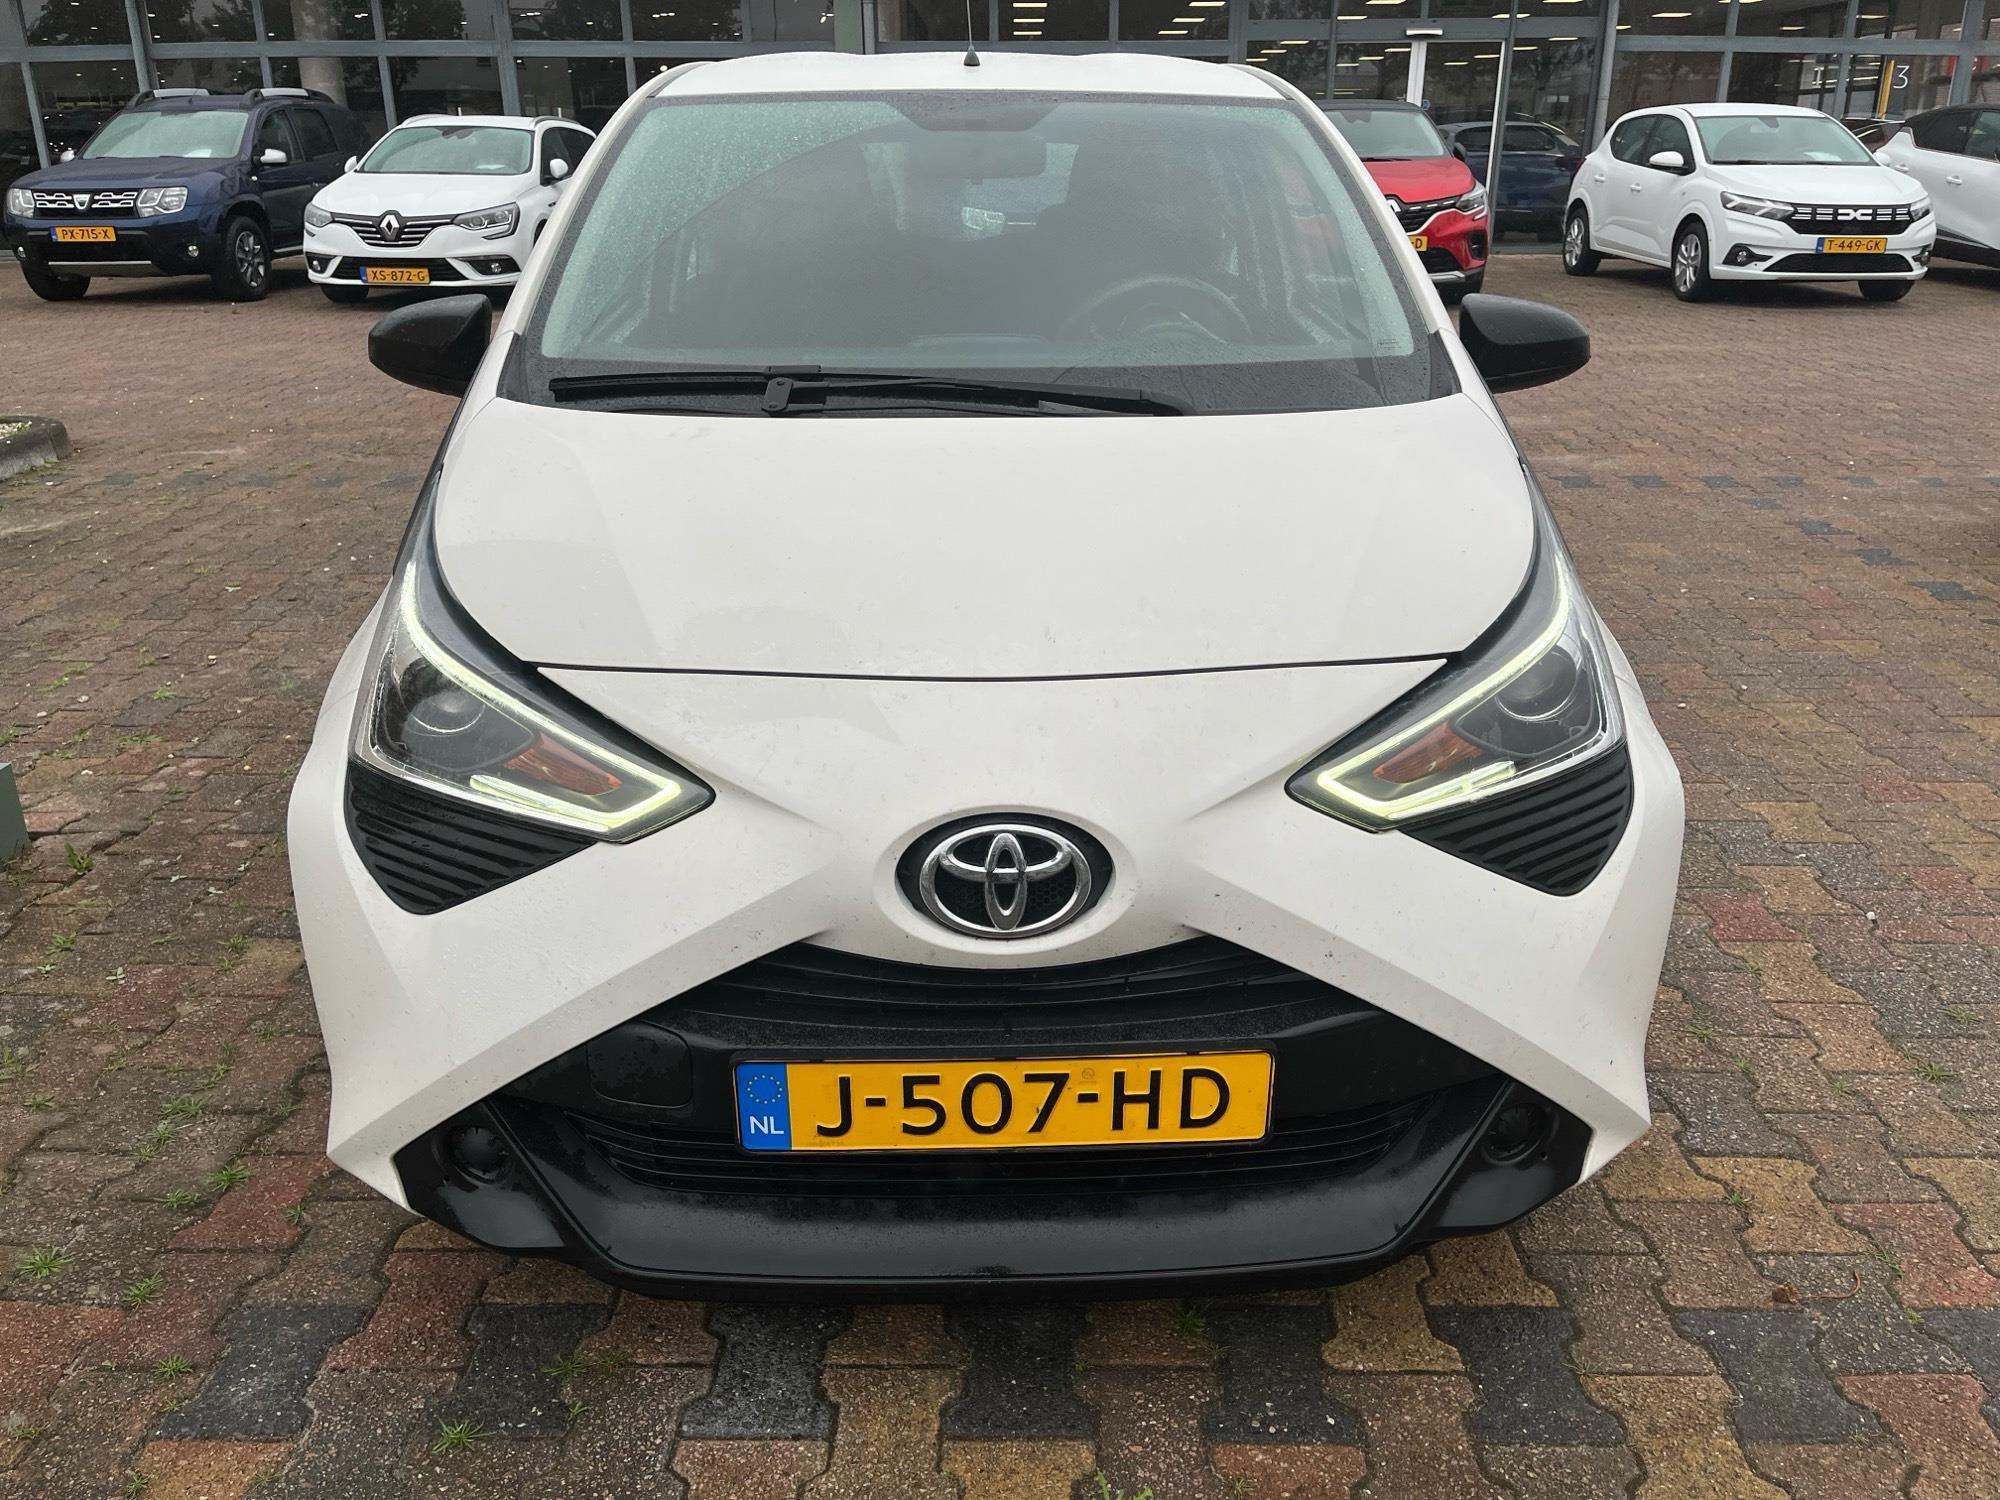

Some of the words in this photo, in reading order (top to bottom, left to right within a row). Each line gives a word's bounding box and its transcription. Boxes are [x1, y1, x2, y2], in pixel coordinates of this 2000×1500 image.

[62, 228, 111, 240] PX-715-X
[1827, 239, 1882, 251] T-449-GK
[371, 270, 425, 281] XS-872-G
[816, 1067, 1231, 1137] J-507-HD
[749, 1115, 785, 1135] NL
